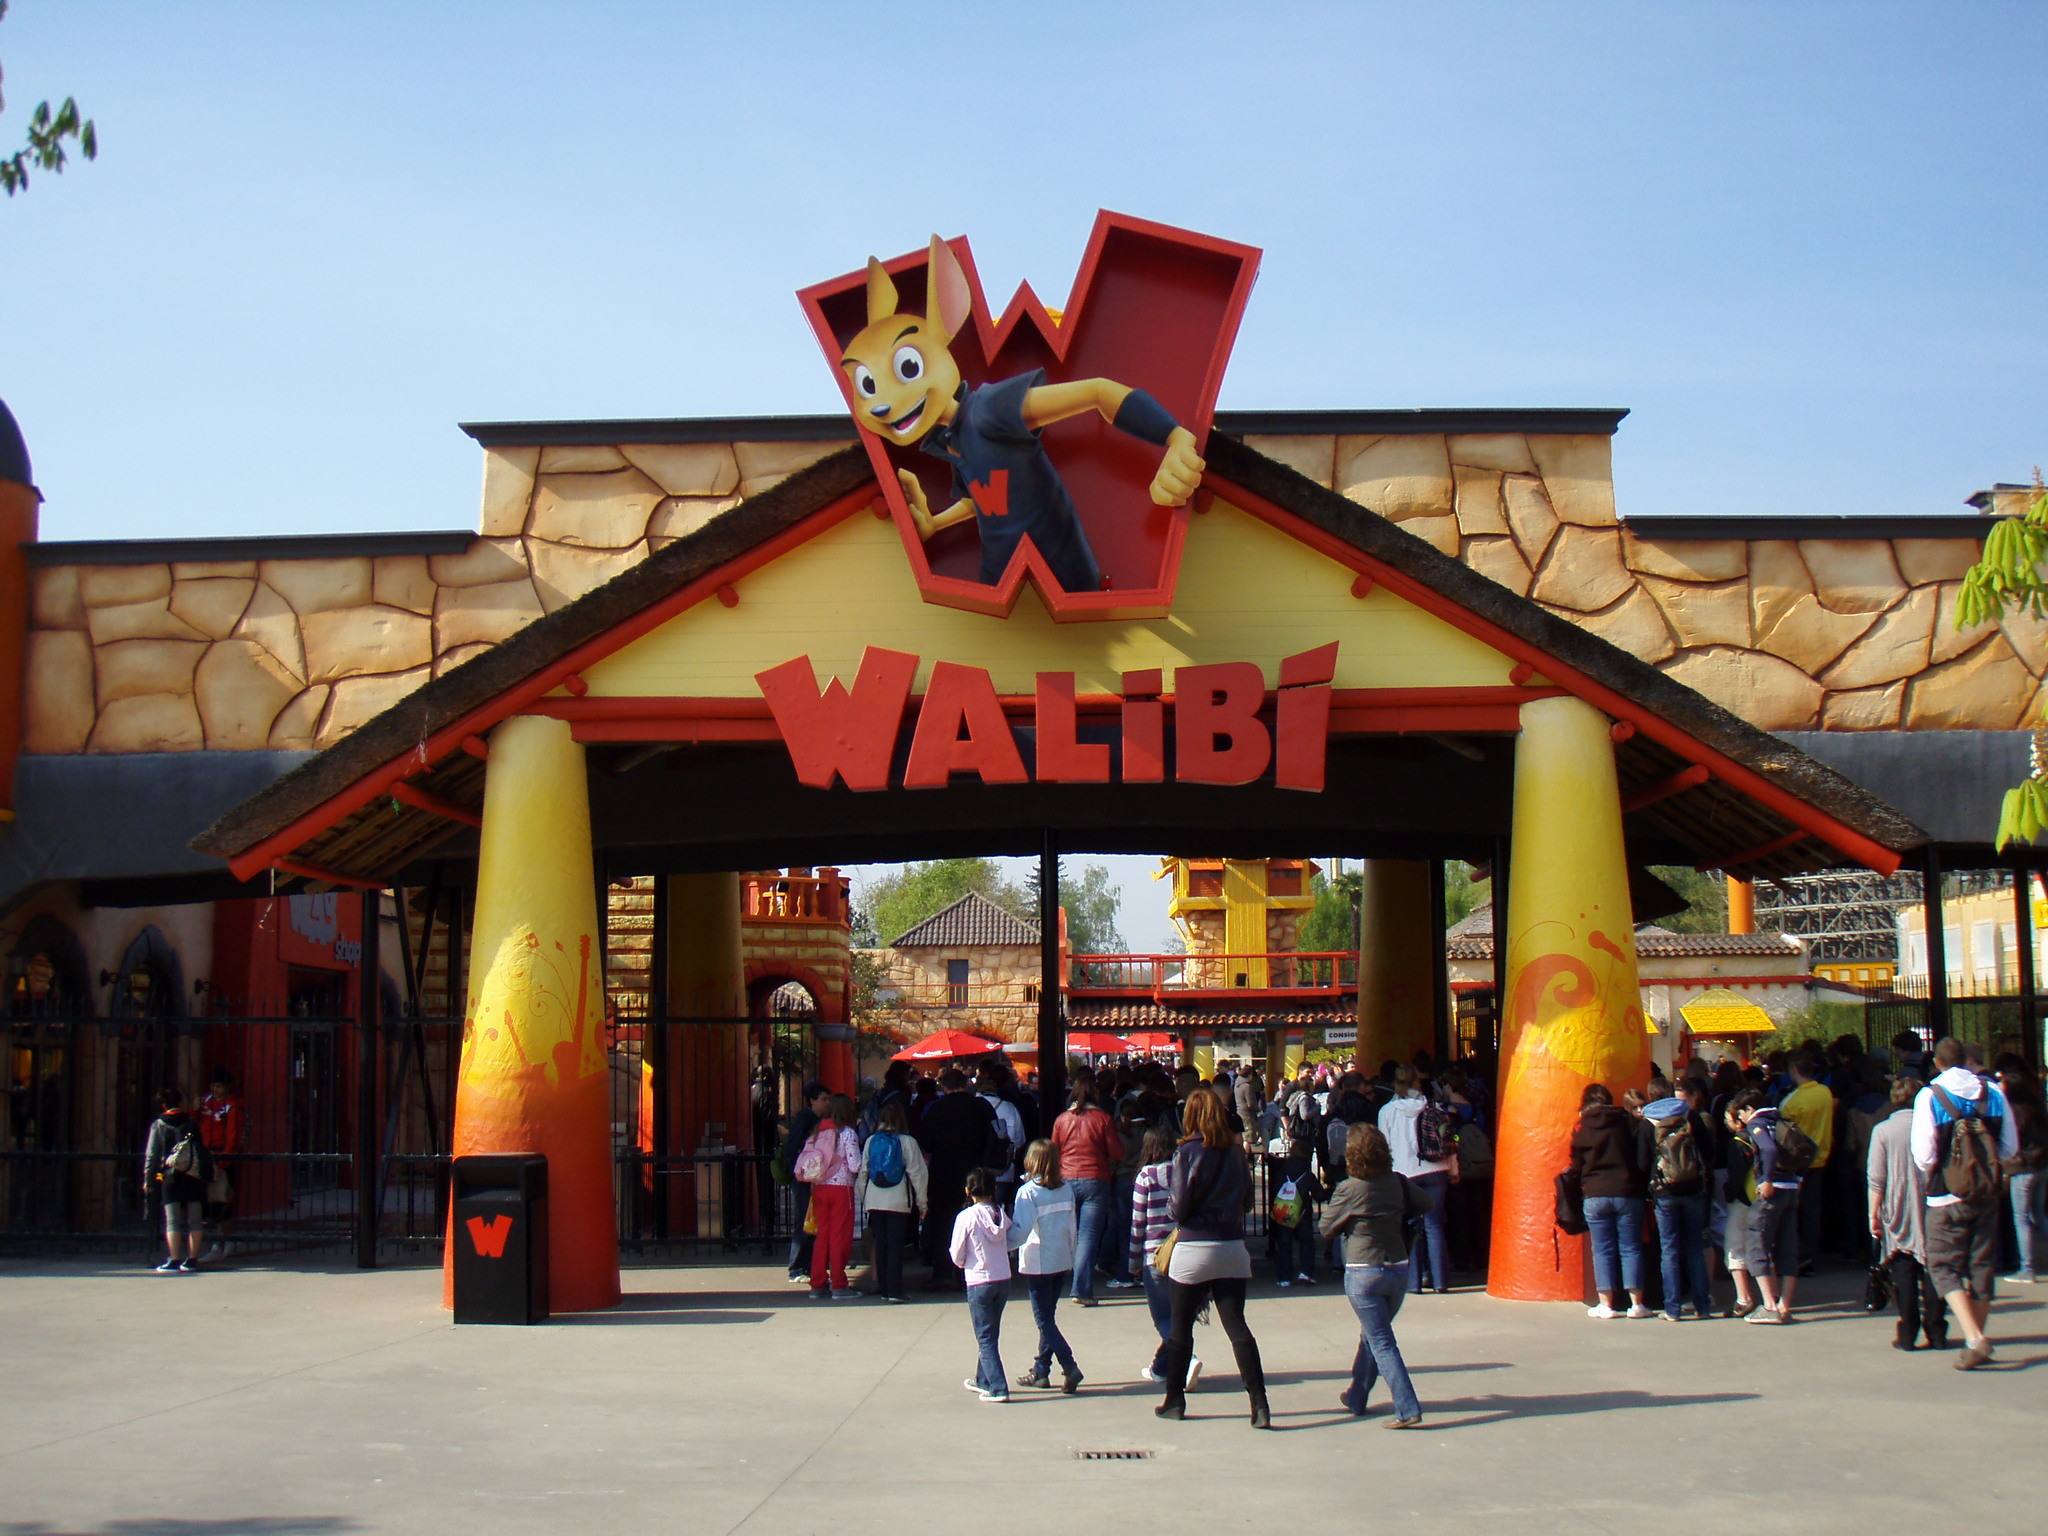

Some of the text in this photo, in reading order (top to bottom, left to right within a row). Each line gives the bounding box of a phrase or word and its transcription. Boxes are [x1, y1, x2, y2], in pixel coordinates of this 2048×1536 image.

[796, 209, 1263, 622] W
[968, 469, 1009, 516] W
[466, 1214, 513, 1258] W
